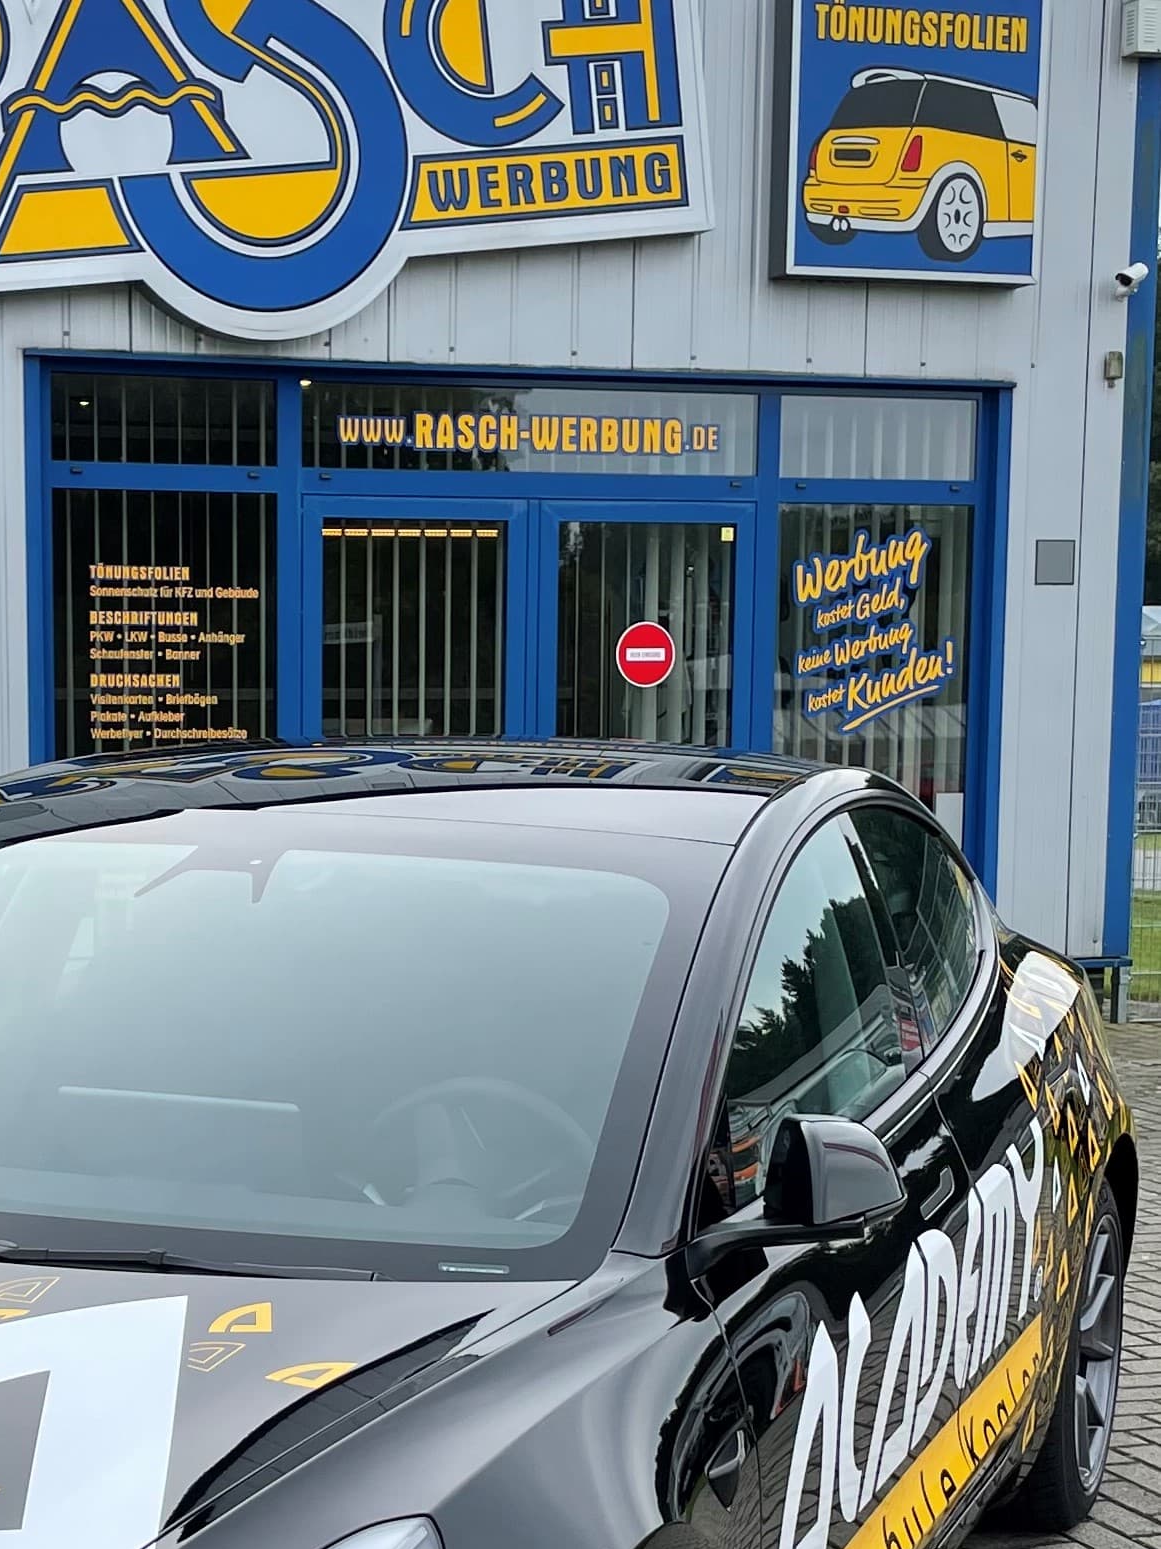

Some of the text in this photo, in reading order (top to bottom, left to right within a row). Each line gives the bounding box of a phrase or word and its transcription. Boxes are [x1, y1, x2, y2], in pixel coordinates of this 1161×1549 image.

[814, 0, 1028, 54] TÖNUNGSFOLIEN
[427, 151, 672, 213] WERBUNG
[89, 562, 190, 580] TÖNUNGSFOLIEN
[795, 530, 929, 603] Werbung
[89, 584, 259, 599] Sonnenschutz für KFZ und Gebäude
[816, 576, 905, 630] kostet Geld,
[89, 610, 198, 626] BESCHRIFTUNGEN
[89, 630, 245, 645] PKW LKW Busse Anhänger
[89, 648, 201, 660] Schaufenster Banner
[797, 621, 914, 675] keine Werbung
[90, 673, 180, 688] DRUCKSACHEN
[806, 640, 954, 713] kostet Kunden!
[90, 693, 218, 707] Visitenkarten Briefbögen
[90, 711, 185, 722] Plakate Aufkleber
[90, 727, 248, 741] Werbeflyer Durchschreibesätze
